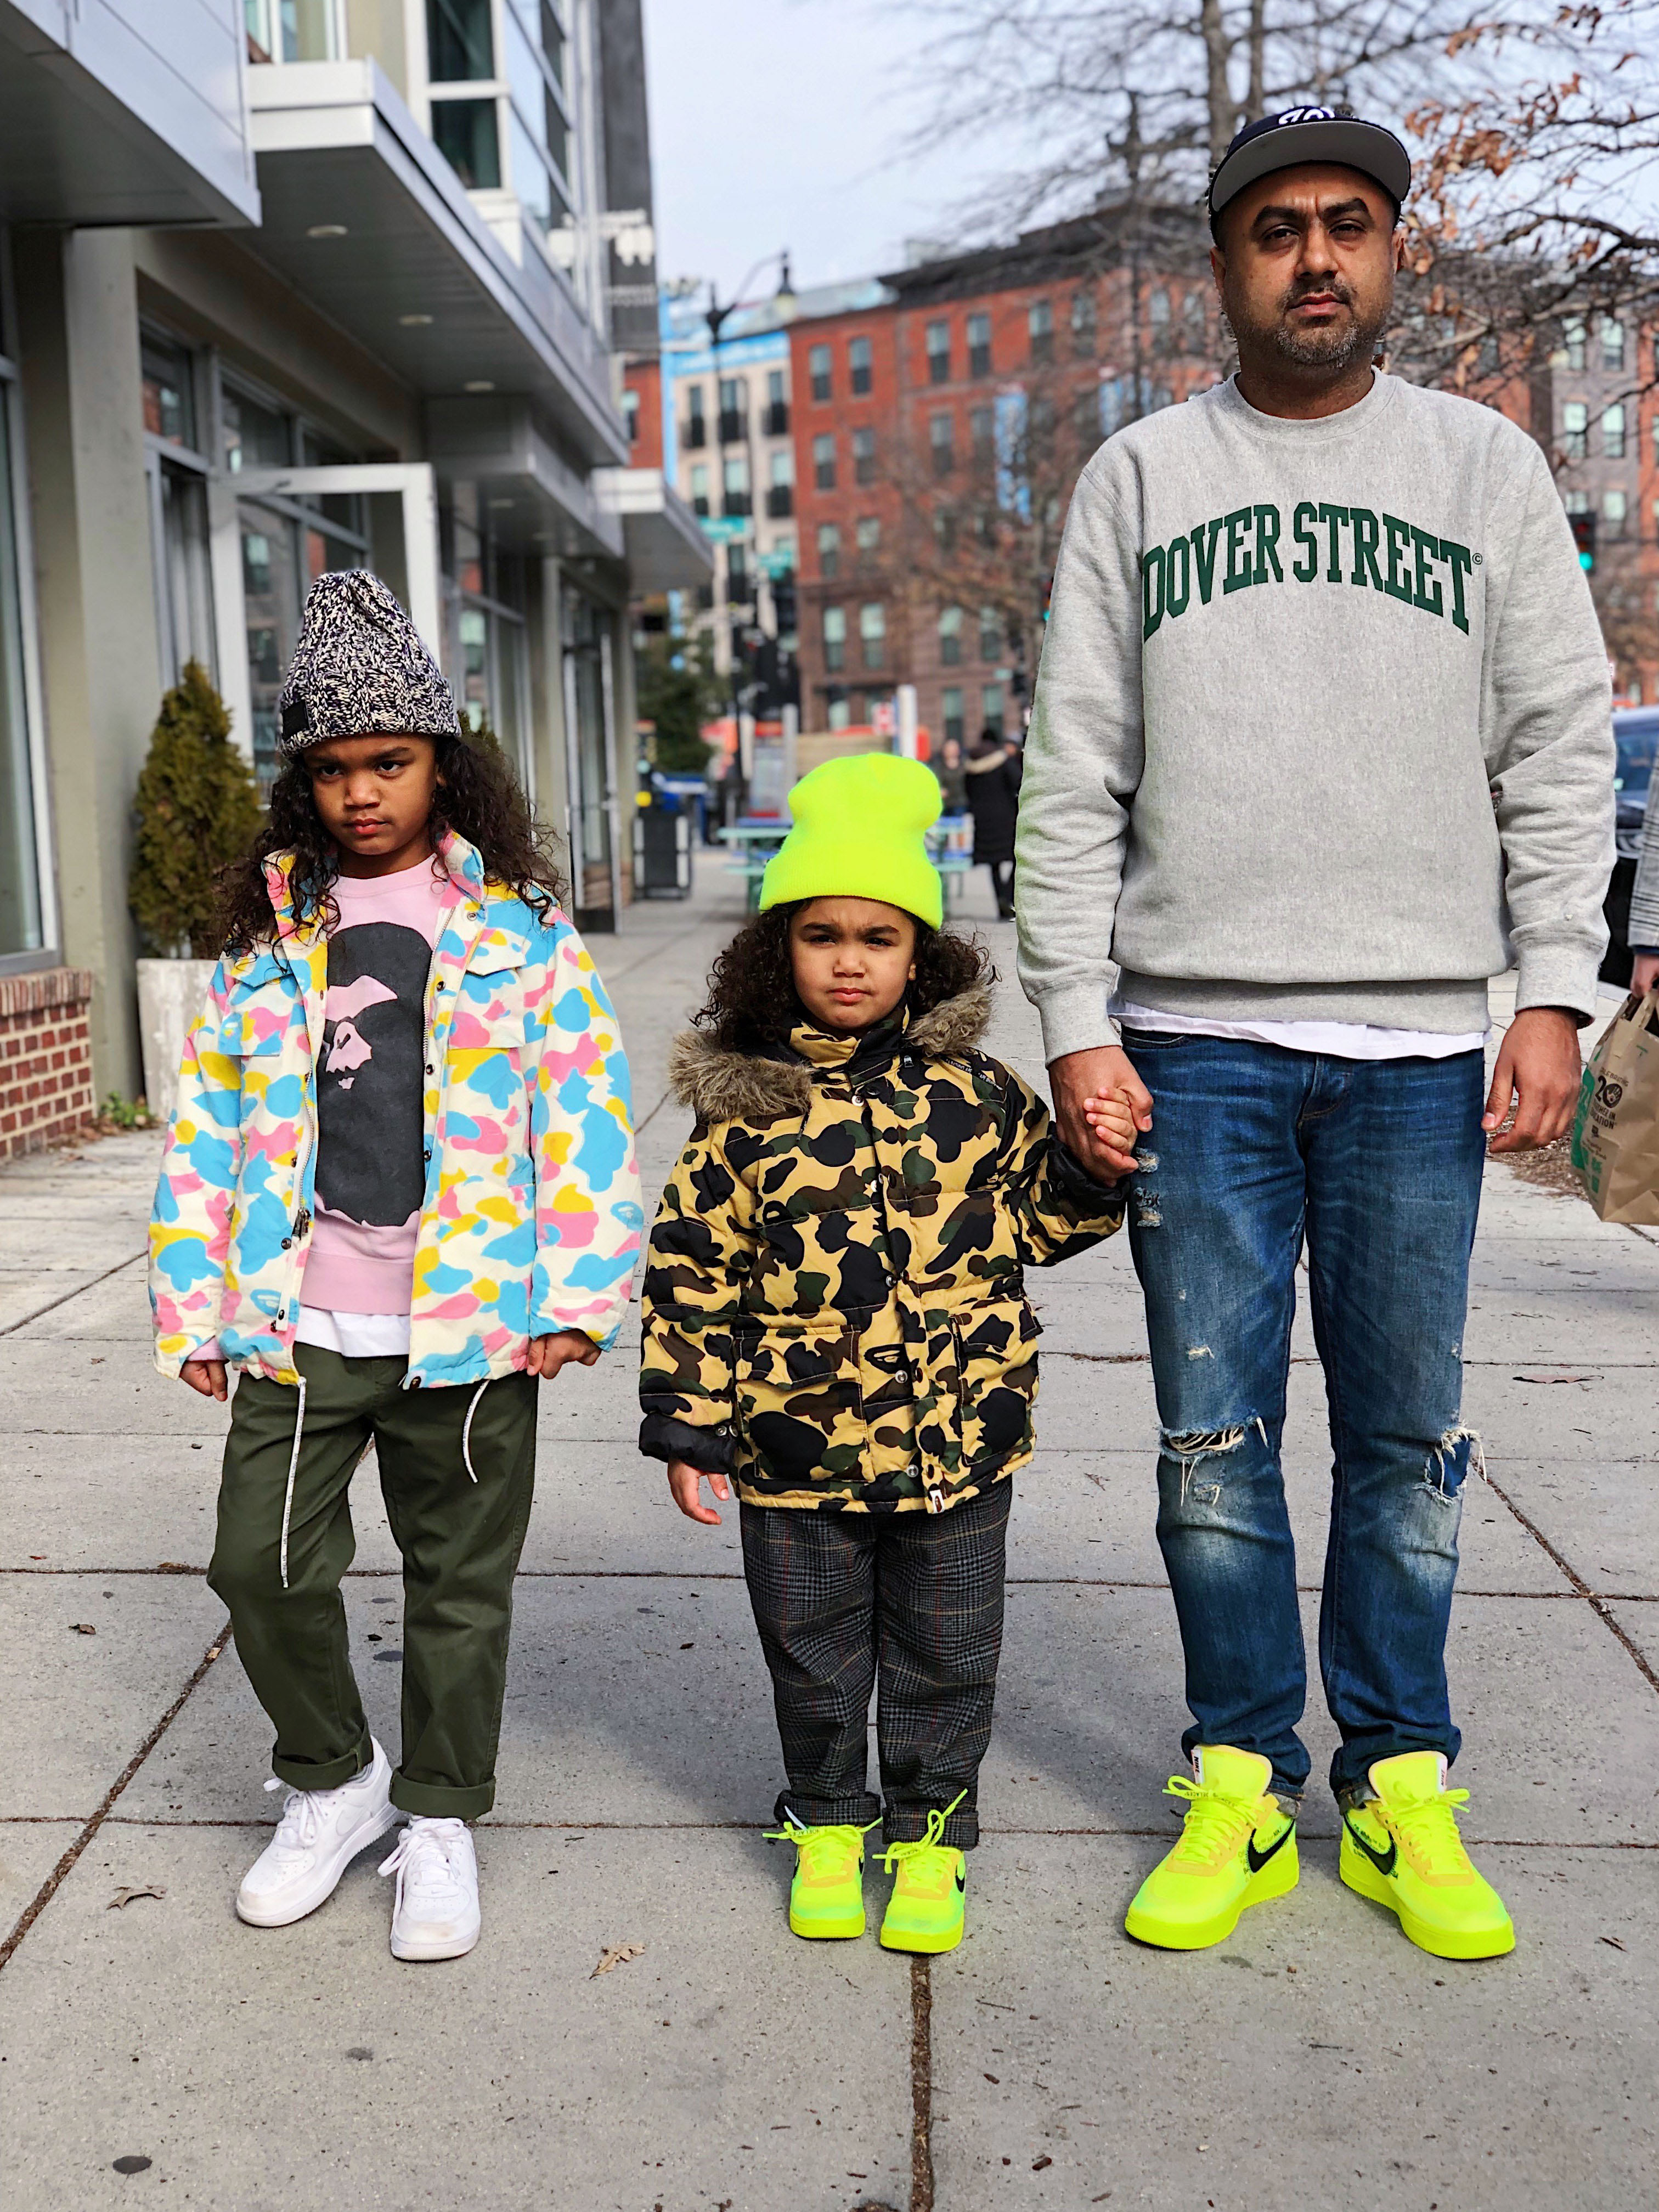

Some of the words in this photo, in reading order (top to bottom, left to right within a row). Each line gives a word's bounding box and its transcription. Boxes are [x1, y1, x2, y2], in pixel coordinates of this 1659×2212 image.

[1142, 504, 1284, 644] DOVER
[1293, 501, 1472, 636] STREET
[1595, 1075, 1623, 1108] 20
